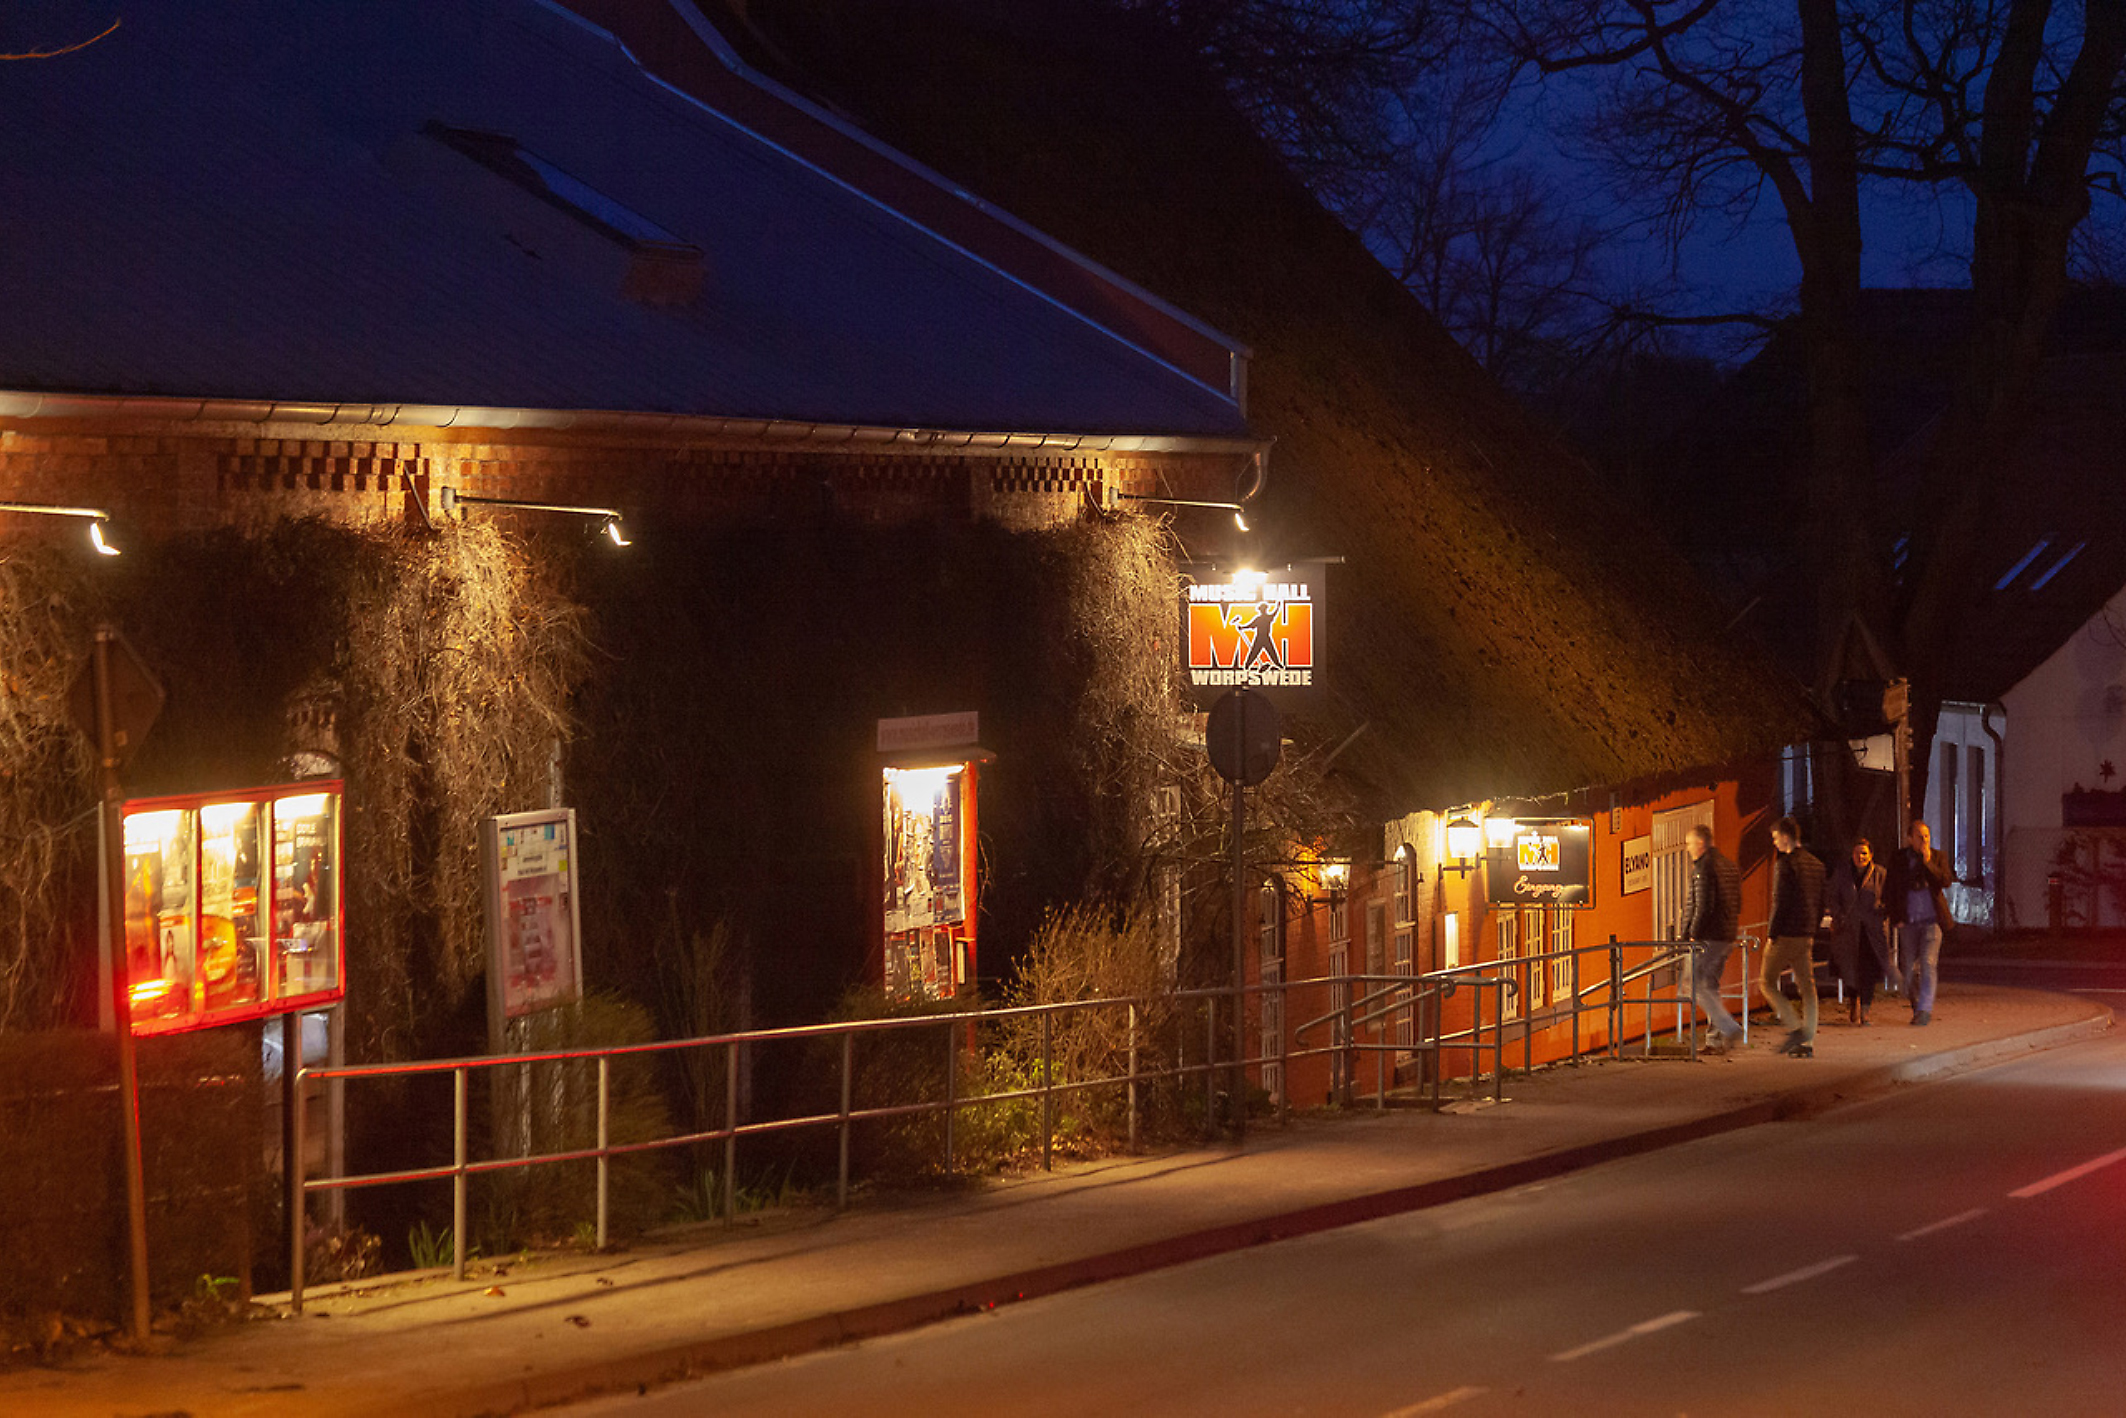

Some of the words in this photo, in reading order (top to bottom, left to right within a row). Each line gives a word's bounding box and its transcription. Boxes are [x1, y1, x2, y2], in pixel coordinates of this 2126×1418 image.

[1190, 584, 1256, 601] MUSC
[1191, 669, 1312, 686] WORPSWEDE
[1514, 875, 1564, 898] Eingang
